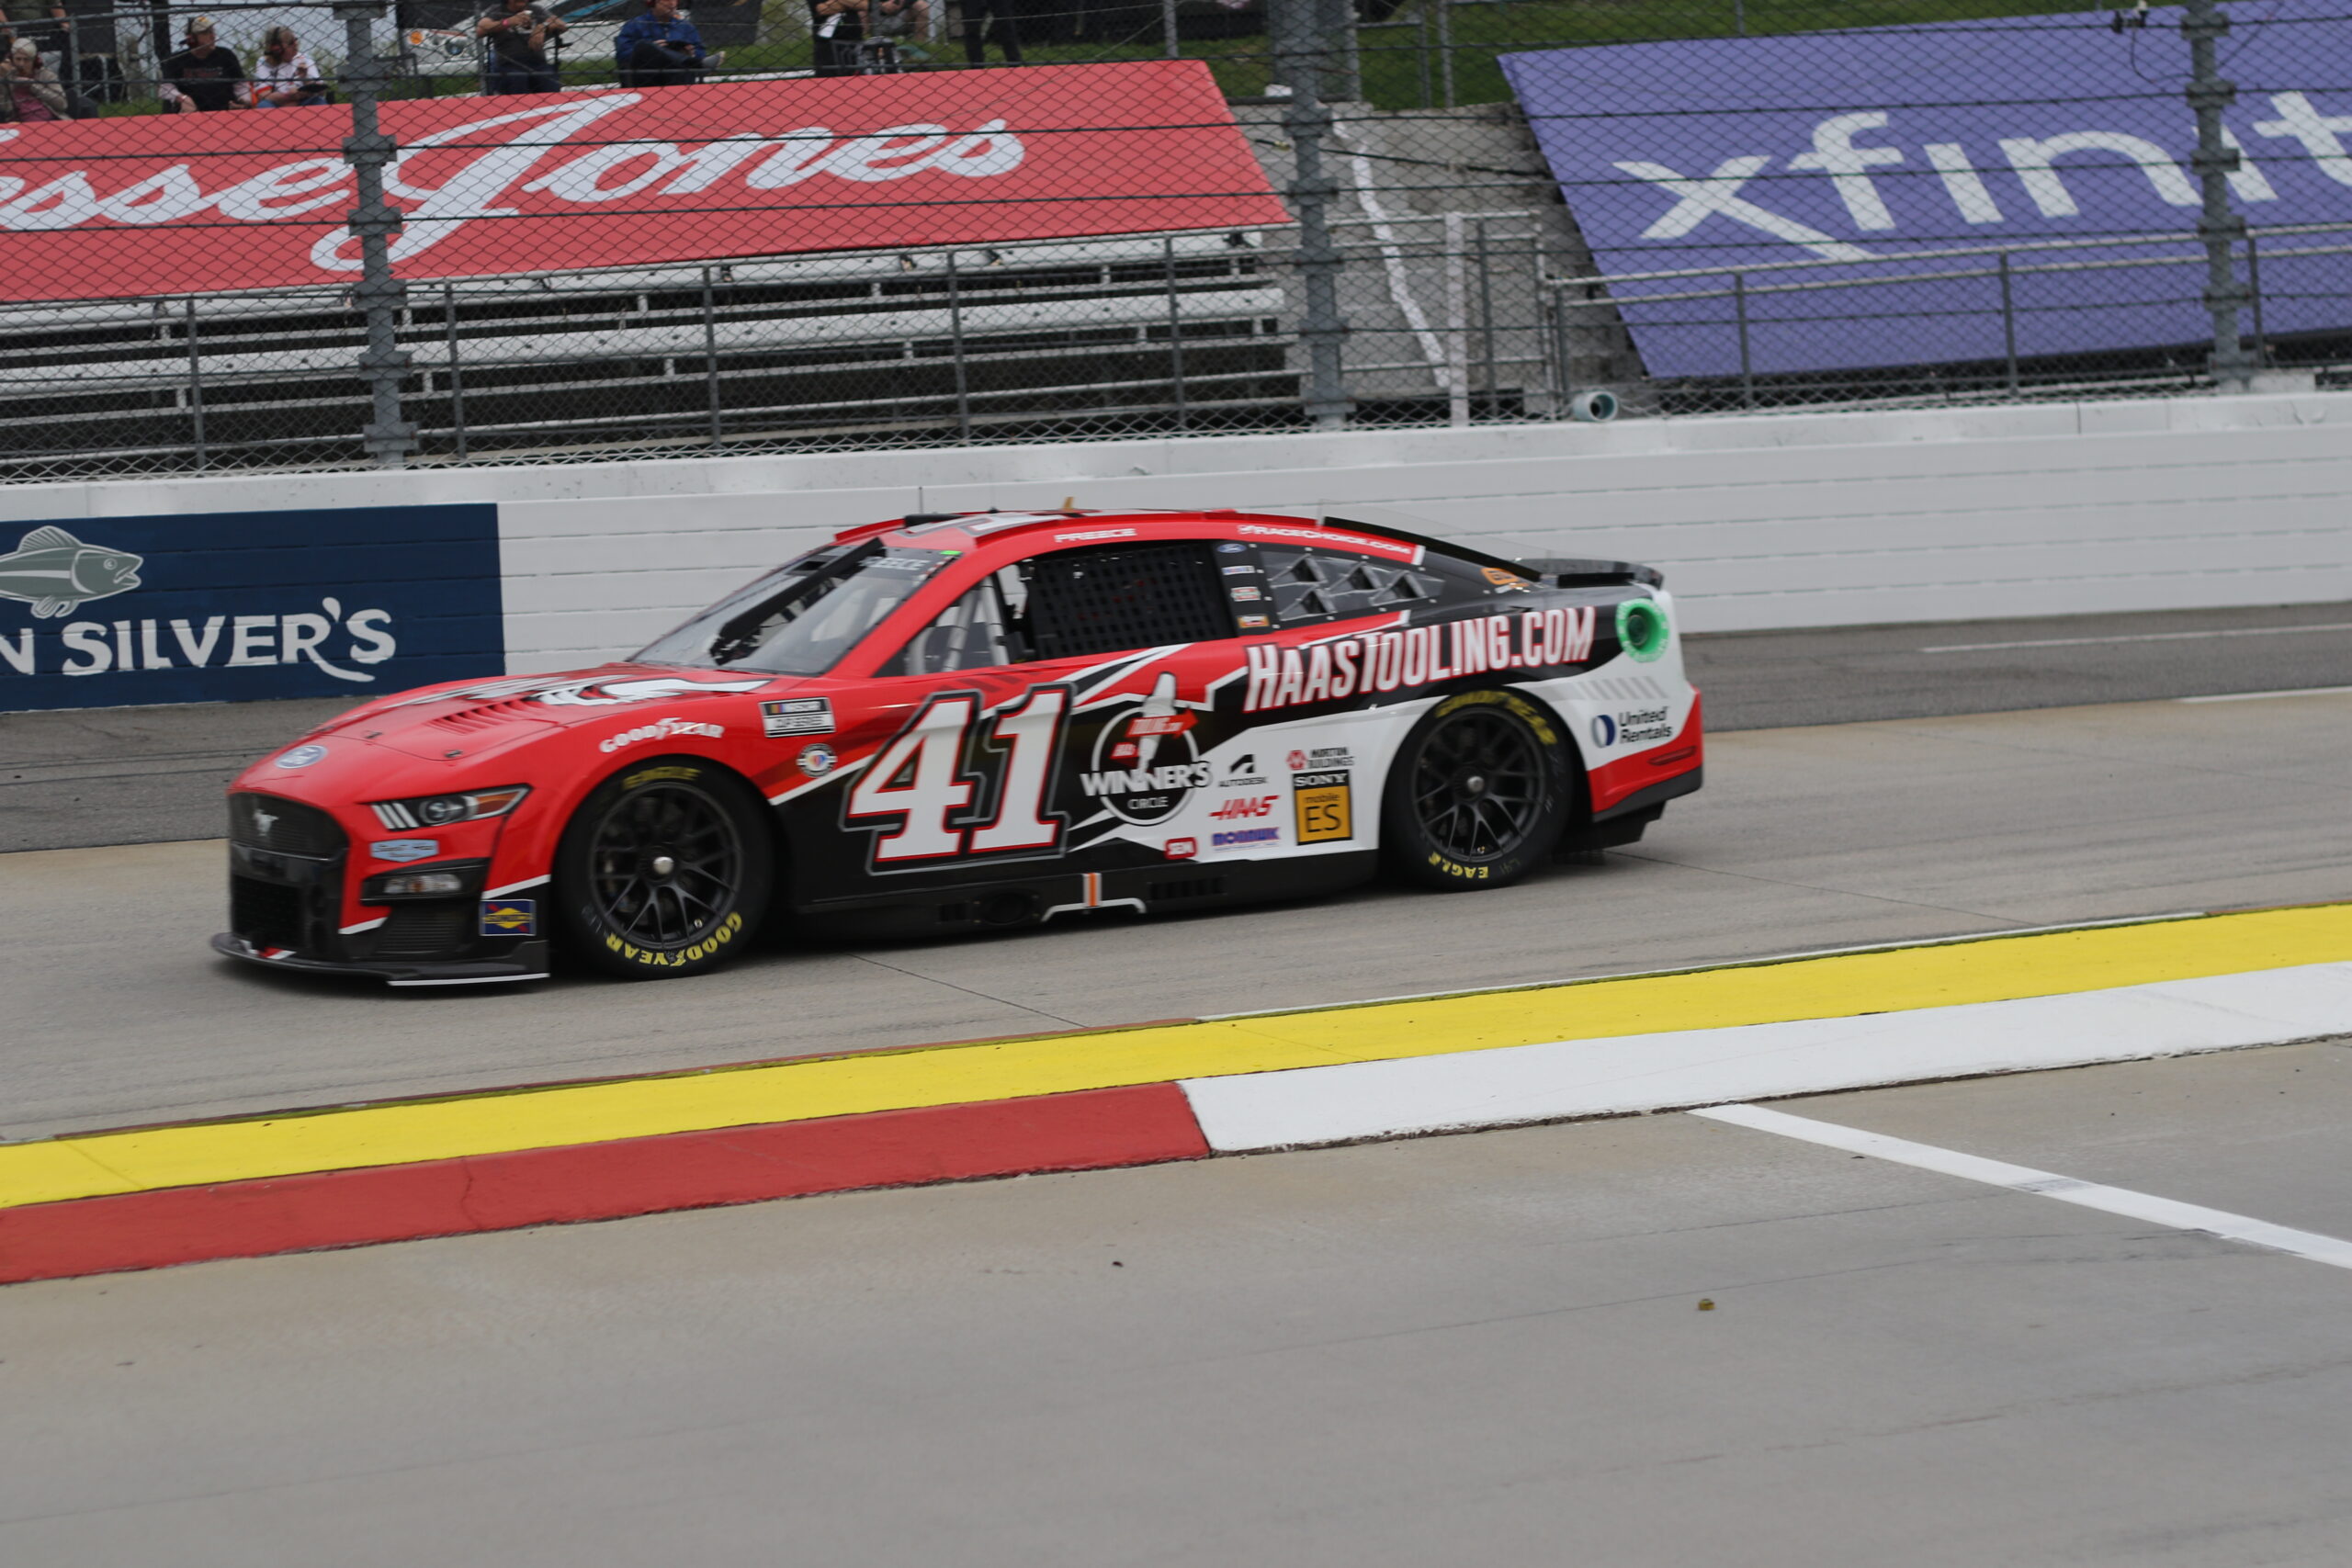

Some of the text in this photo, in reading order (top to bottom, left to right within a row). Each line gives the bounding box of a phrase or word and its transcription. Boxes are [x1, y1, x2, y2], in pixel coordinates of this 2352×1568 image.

[0, 93, 1025, 270] sse Jones
[1053, 528, 1137, 542] PREECE
[62, 597, 396, 682] SILVER'S
[1243, 605, 1596, 713] HAASTOOLING.COM
[1619, 706, 1668, 727] United
[1620, 723, 1672, 744] Rentals
[843, 683, 1071, 867] 41
[1217, 776, 1268, 788] AUTODESK
[1294, 773, 1348, 787] SONY
[1306, 804, 1341, 833] ES
[1428, 852, 1488, 879] EAGLE
[605, 911, 742, 966] GOODYEAR
